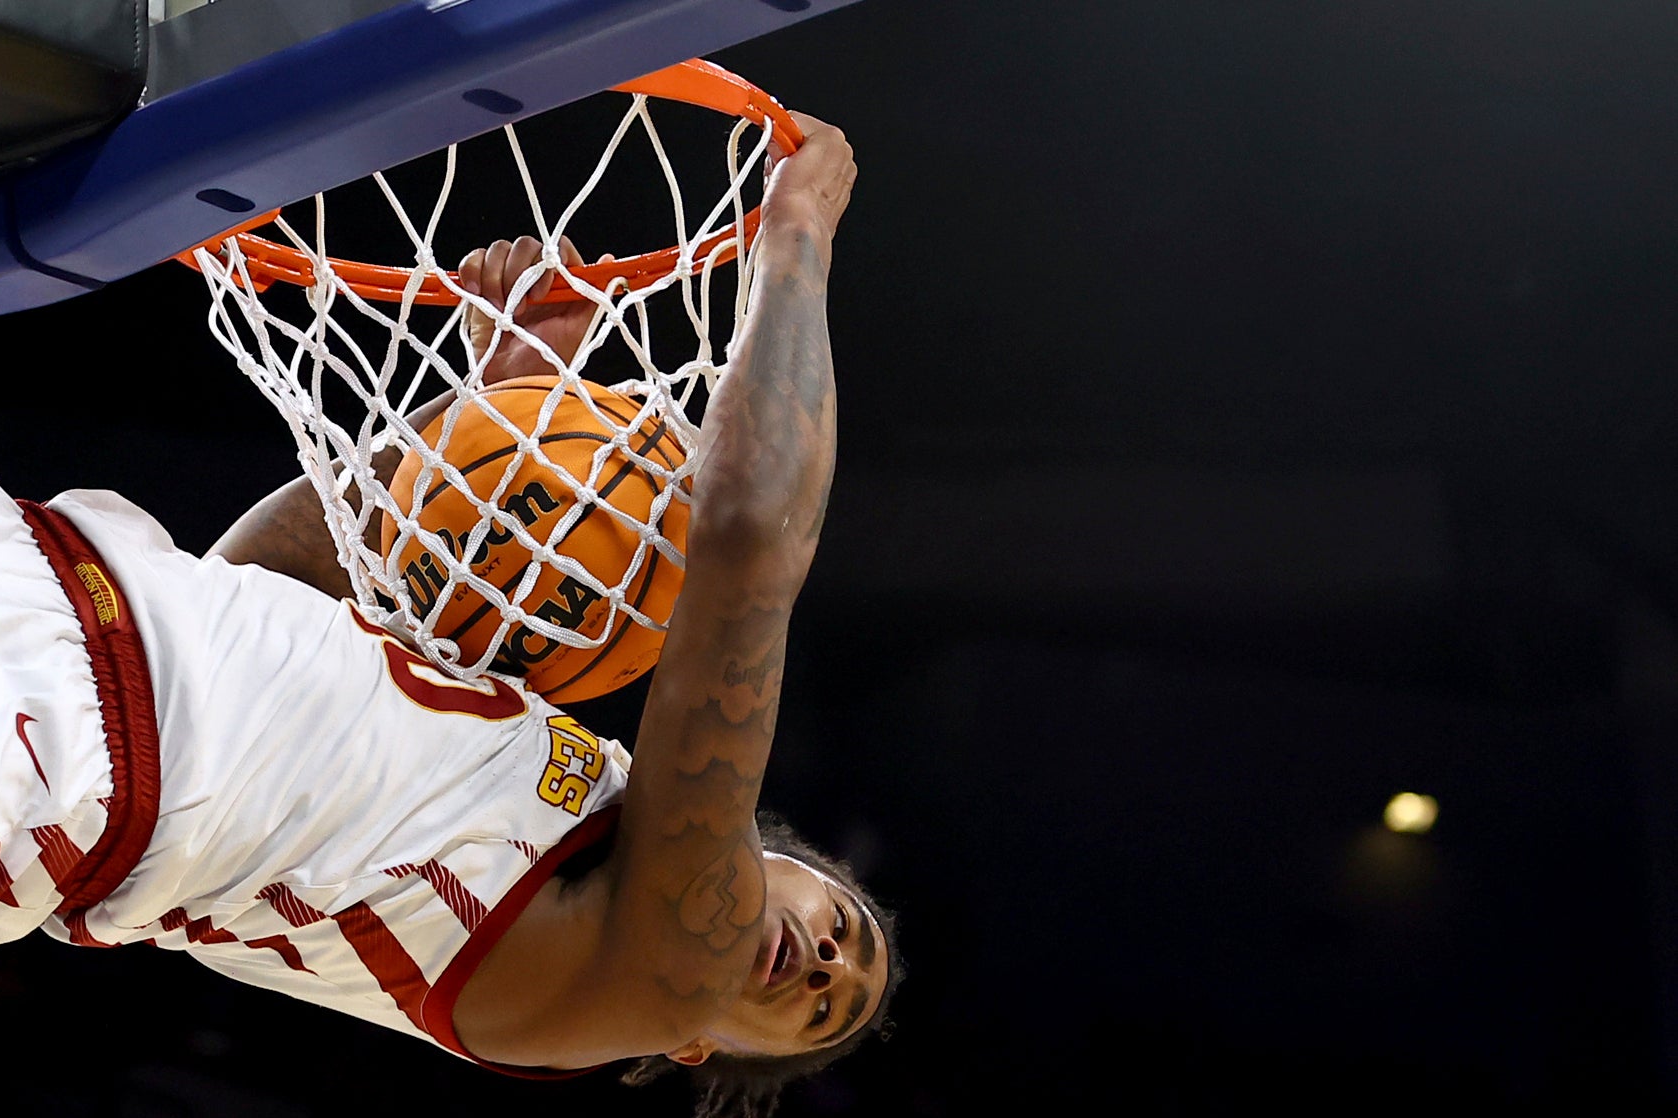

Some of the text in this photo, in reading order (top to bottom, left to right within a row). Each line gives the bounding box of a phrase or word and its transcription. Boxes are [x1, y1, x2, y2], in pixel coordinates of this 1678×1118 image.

[476, 556, 502, 580] NXT
[73, 562, 110, 626] HILTON MAGIC
